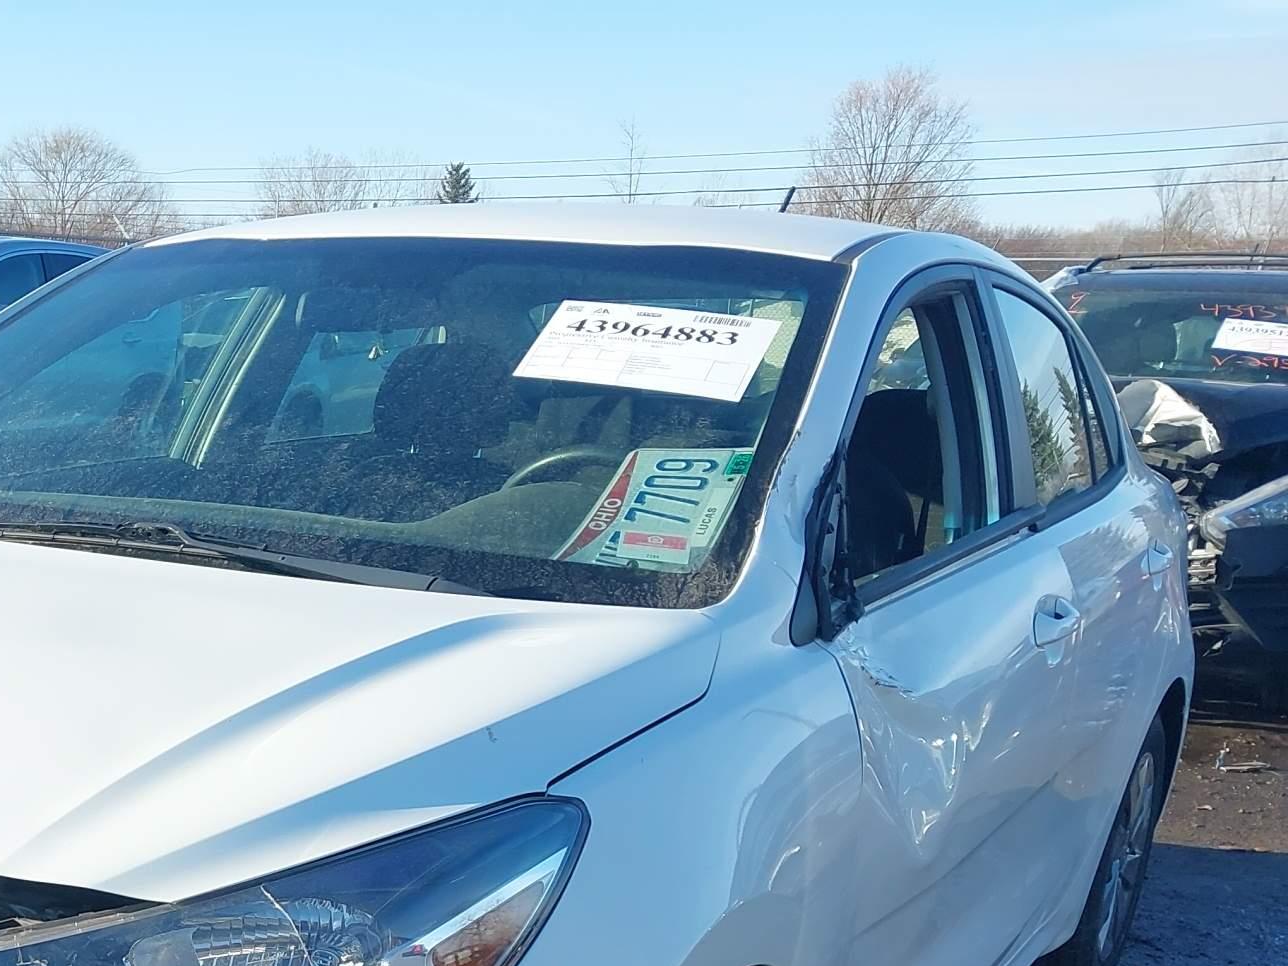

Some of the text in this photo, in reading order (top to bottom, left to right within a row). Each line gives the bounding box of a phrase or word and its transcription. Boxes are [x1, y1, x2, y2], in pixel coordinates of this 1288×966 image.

[567, 318, 738, 345] 43964883
[589, 498, 622, 531] OHIO
[695, 507, 717, 535] LUCAS
